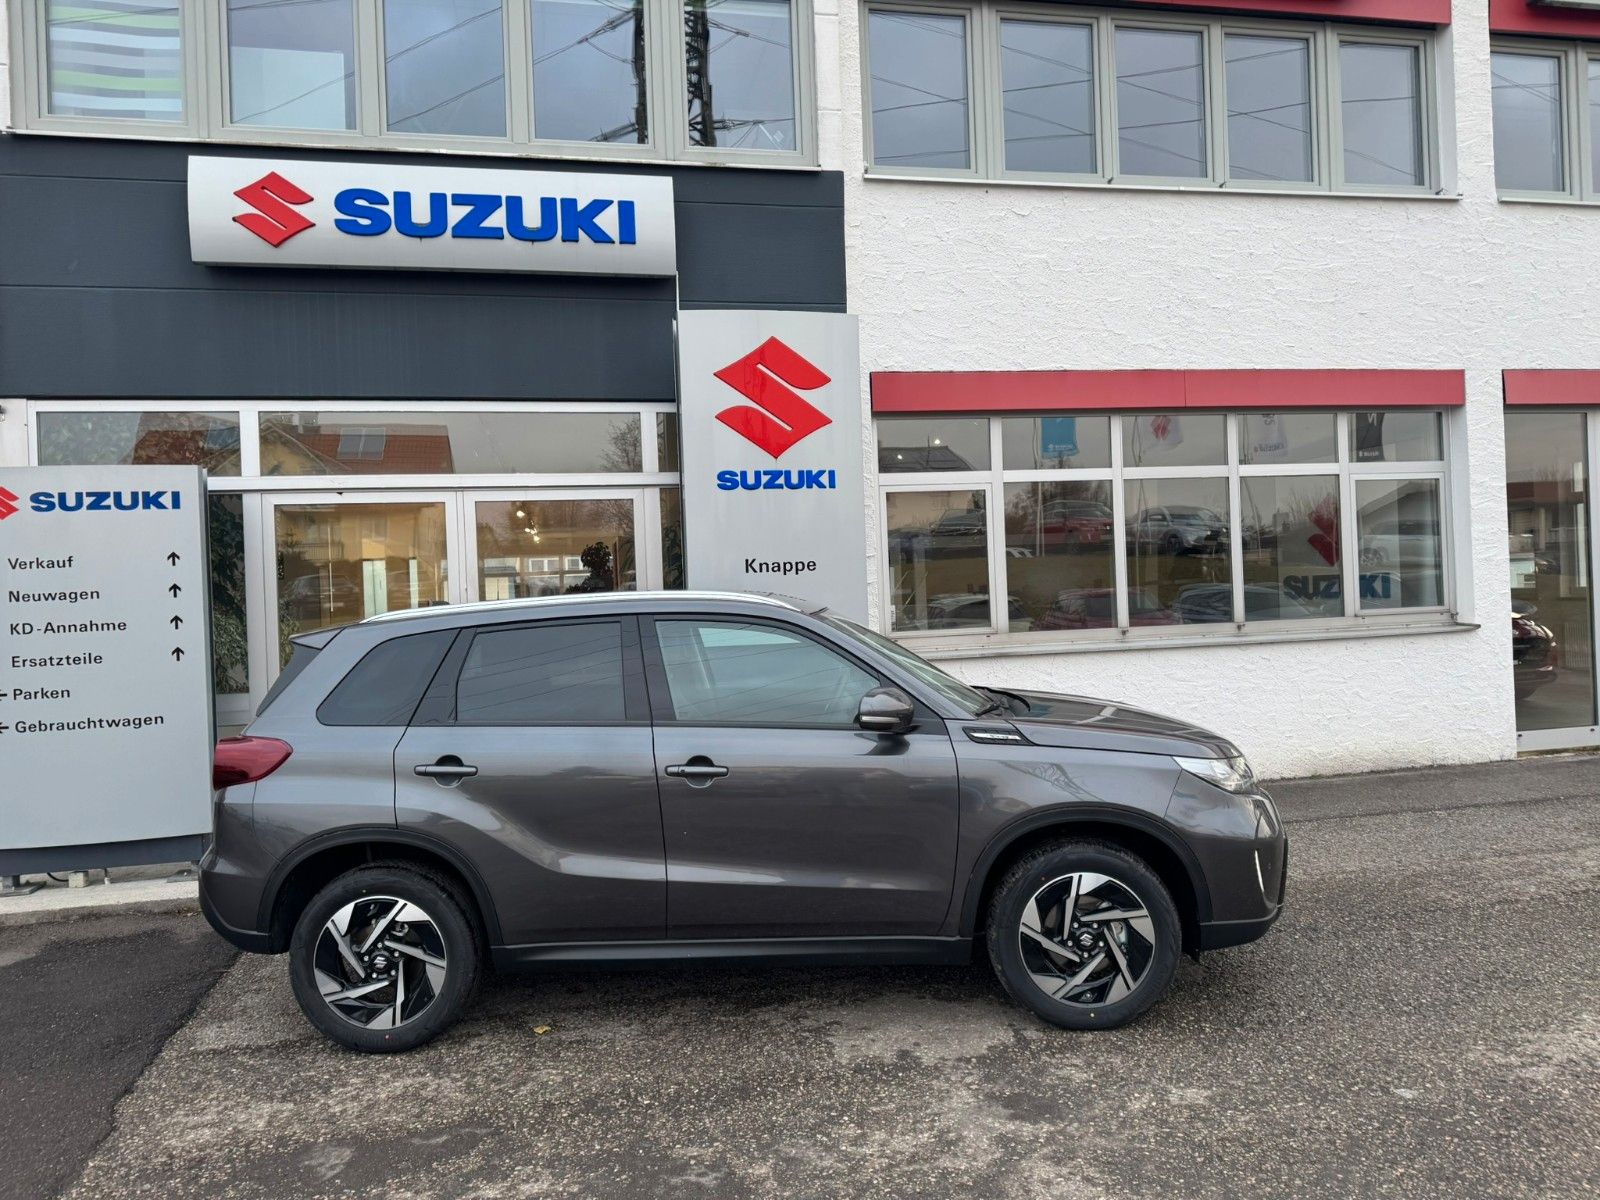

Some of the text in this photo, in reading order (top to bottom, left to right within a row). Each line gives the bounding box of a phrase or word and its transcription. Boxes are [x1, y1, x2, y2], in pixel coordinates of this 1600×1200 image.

[333, 187, 637, 245] SUZUKI
[716, 469, 836, 491] SUZUKI
[29, 490, 182, 513] SUZUKI
[7, 555, 75, 570] Verkauf
[744, 558, 817, 575] Knappe
[1283, 573, 1391, 600] SUZKI
[8, 588, 101, 603] Neuwagen
[9, 619, 128, 636] KD-Annahme
[11, 653, 104, 668] Ersatzteile
[12, 686, 71, 700] Parken
[14, 714, 164, 733] Gebrauchtwagen
